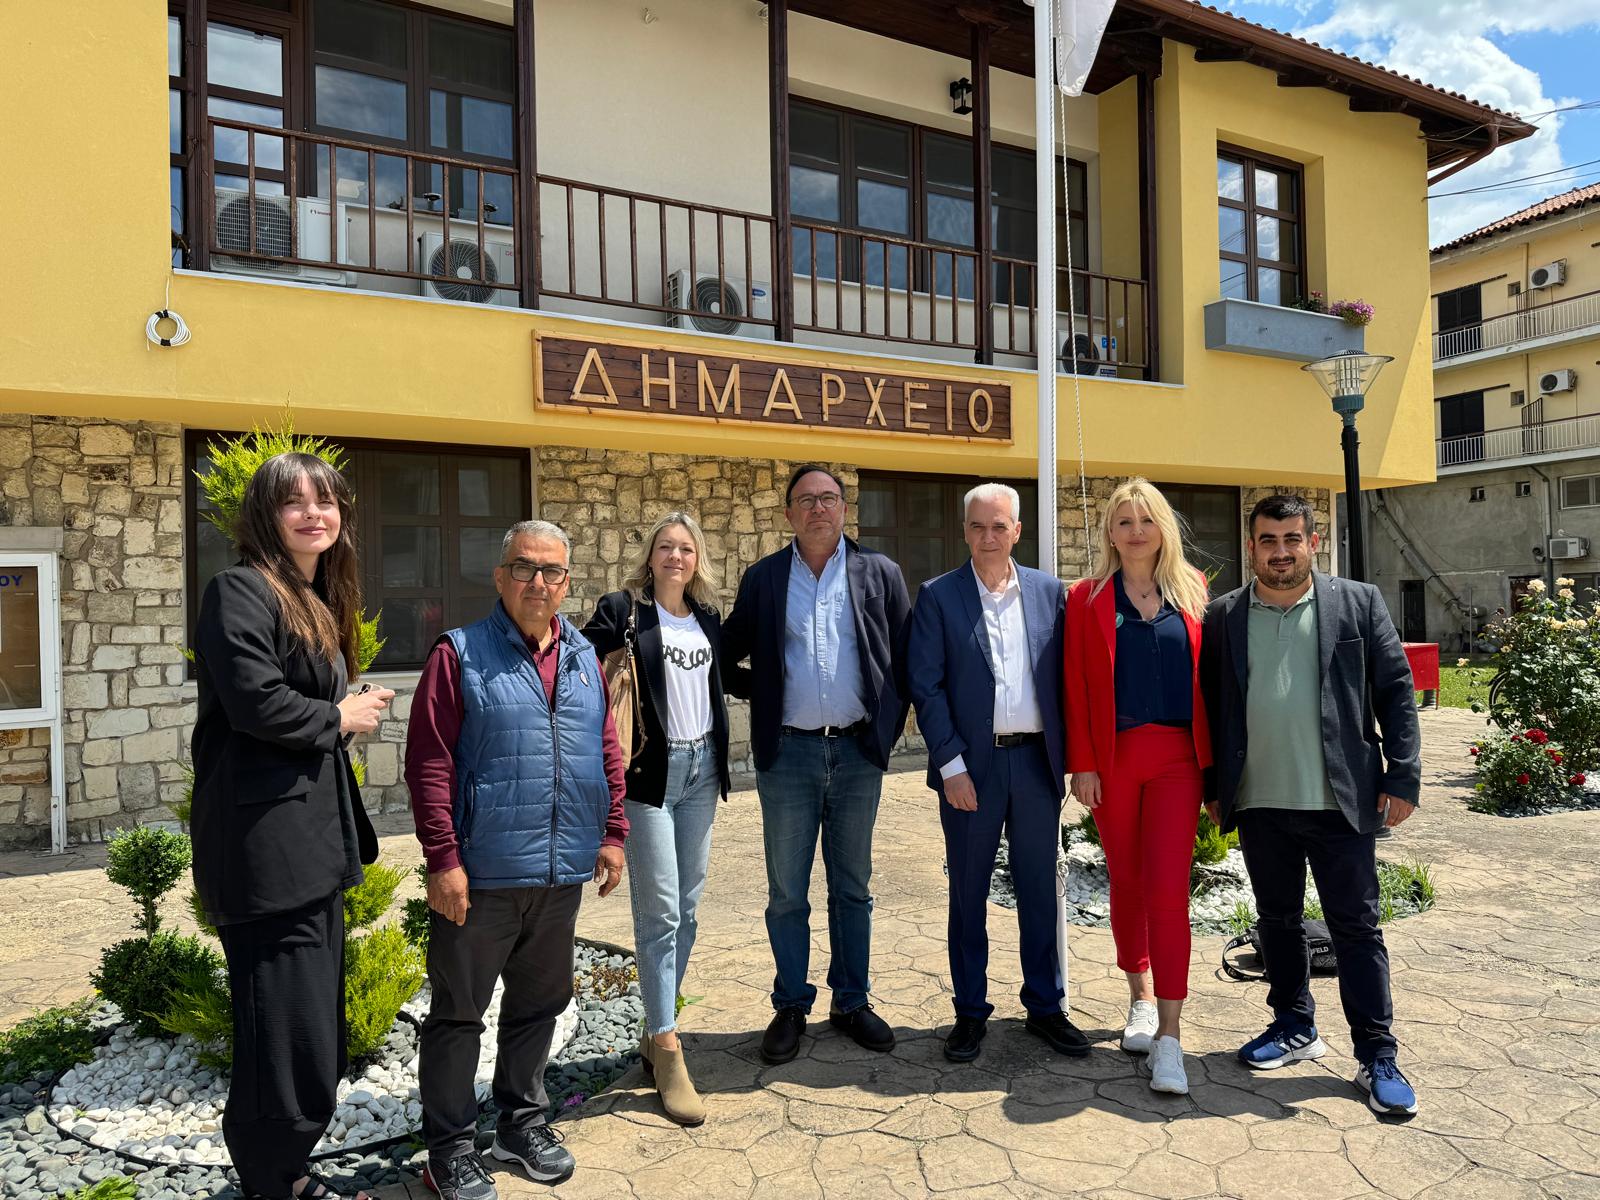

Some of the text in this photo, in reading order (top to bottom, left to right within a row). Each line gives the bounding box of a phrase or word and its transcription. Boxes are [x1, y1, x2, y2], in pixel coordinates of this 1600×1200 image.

[569, 347, 994, 433] ΔΗΜΑΡΧΕΙΟ
[662, 644, 712, 668] ACE LOV
